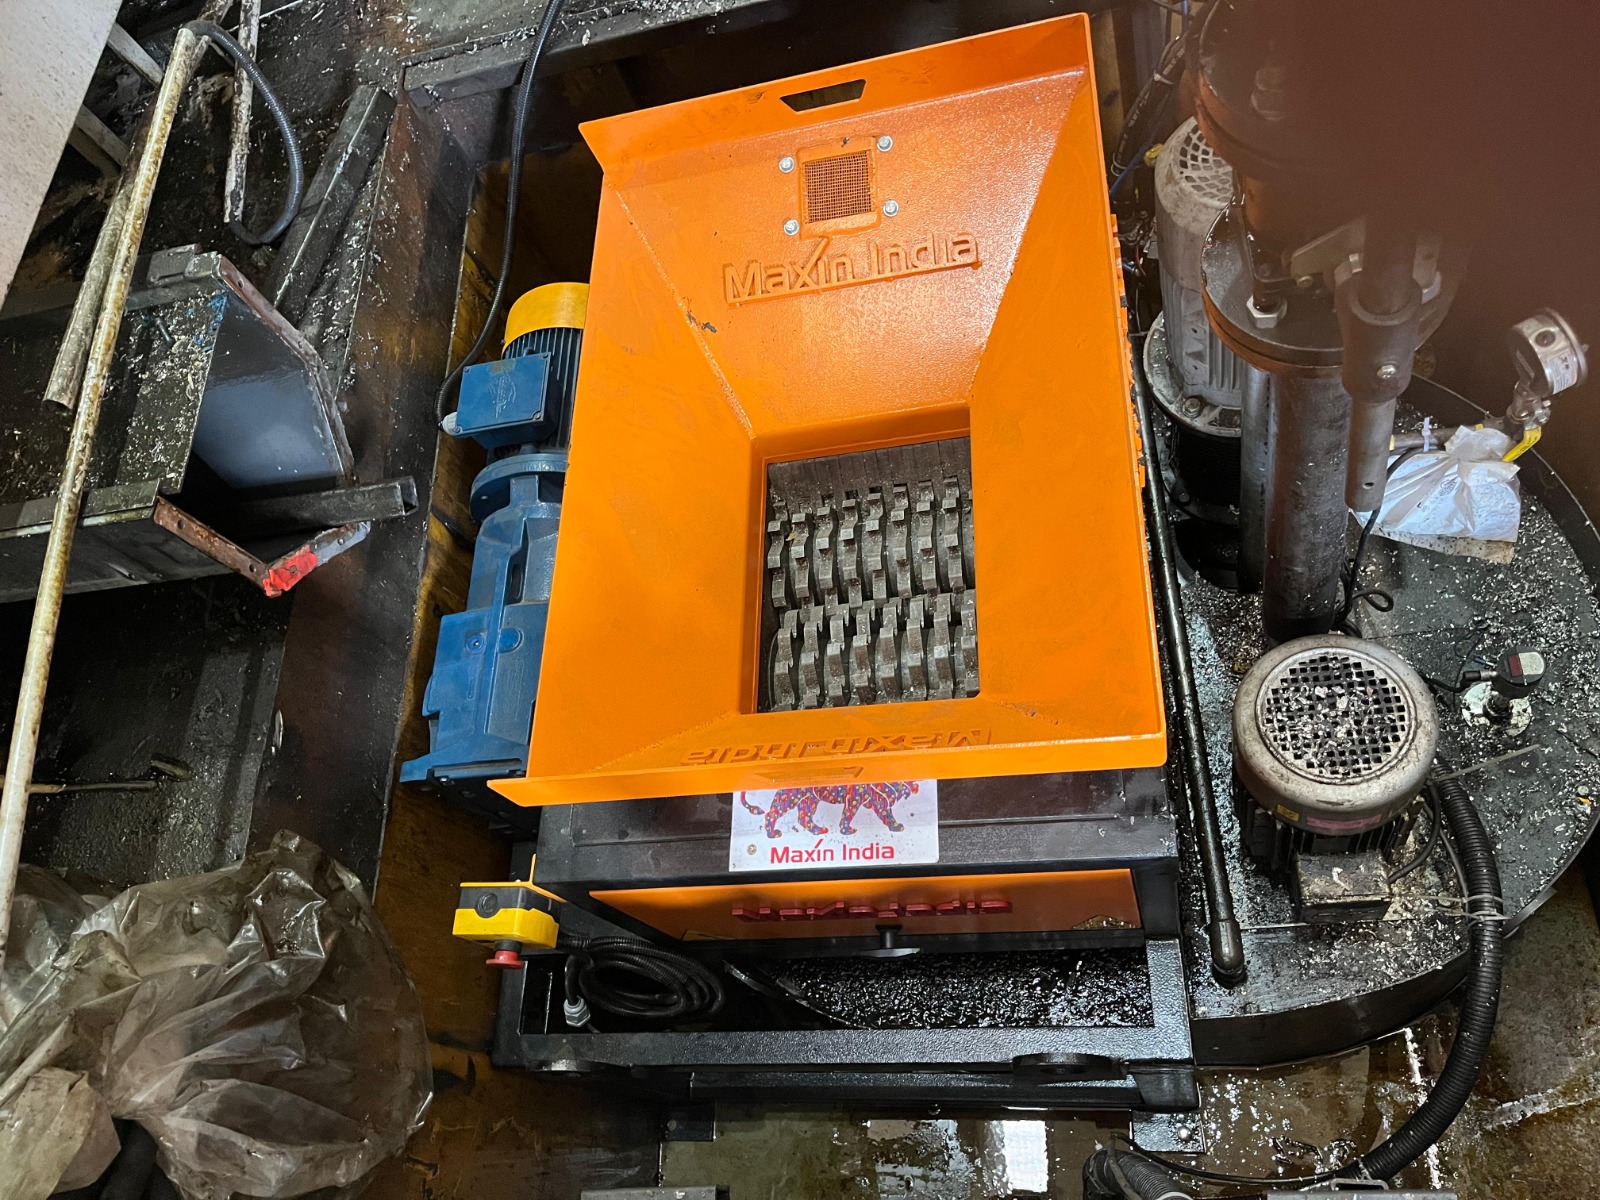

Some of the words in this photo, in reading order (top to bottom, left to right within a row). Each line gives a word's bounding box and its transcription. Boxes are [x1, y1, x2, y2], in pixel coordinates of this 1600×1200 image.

[722, 236, 856, 304] Maxin
[870, 232, 979, 276] India
[770, 838, 834, 864] Maxin
[842, 842, 894, 861] India
